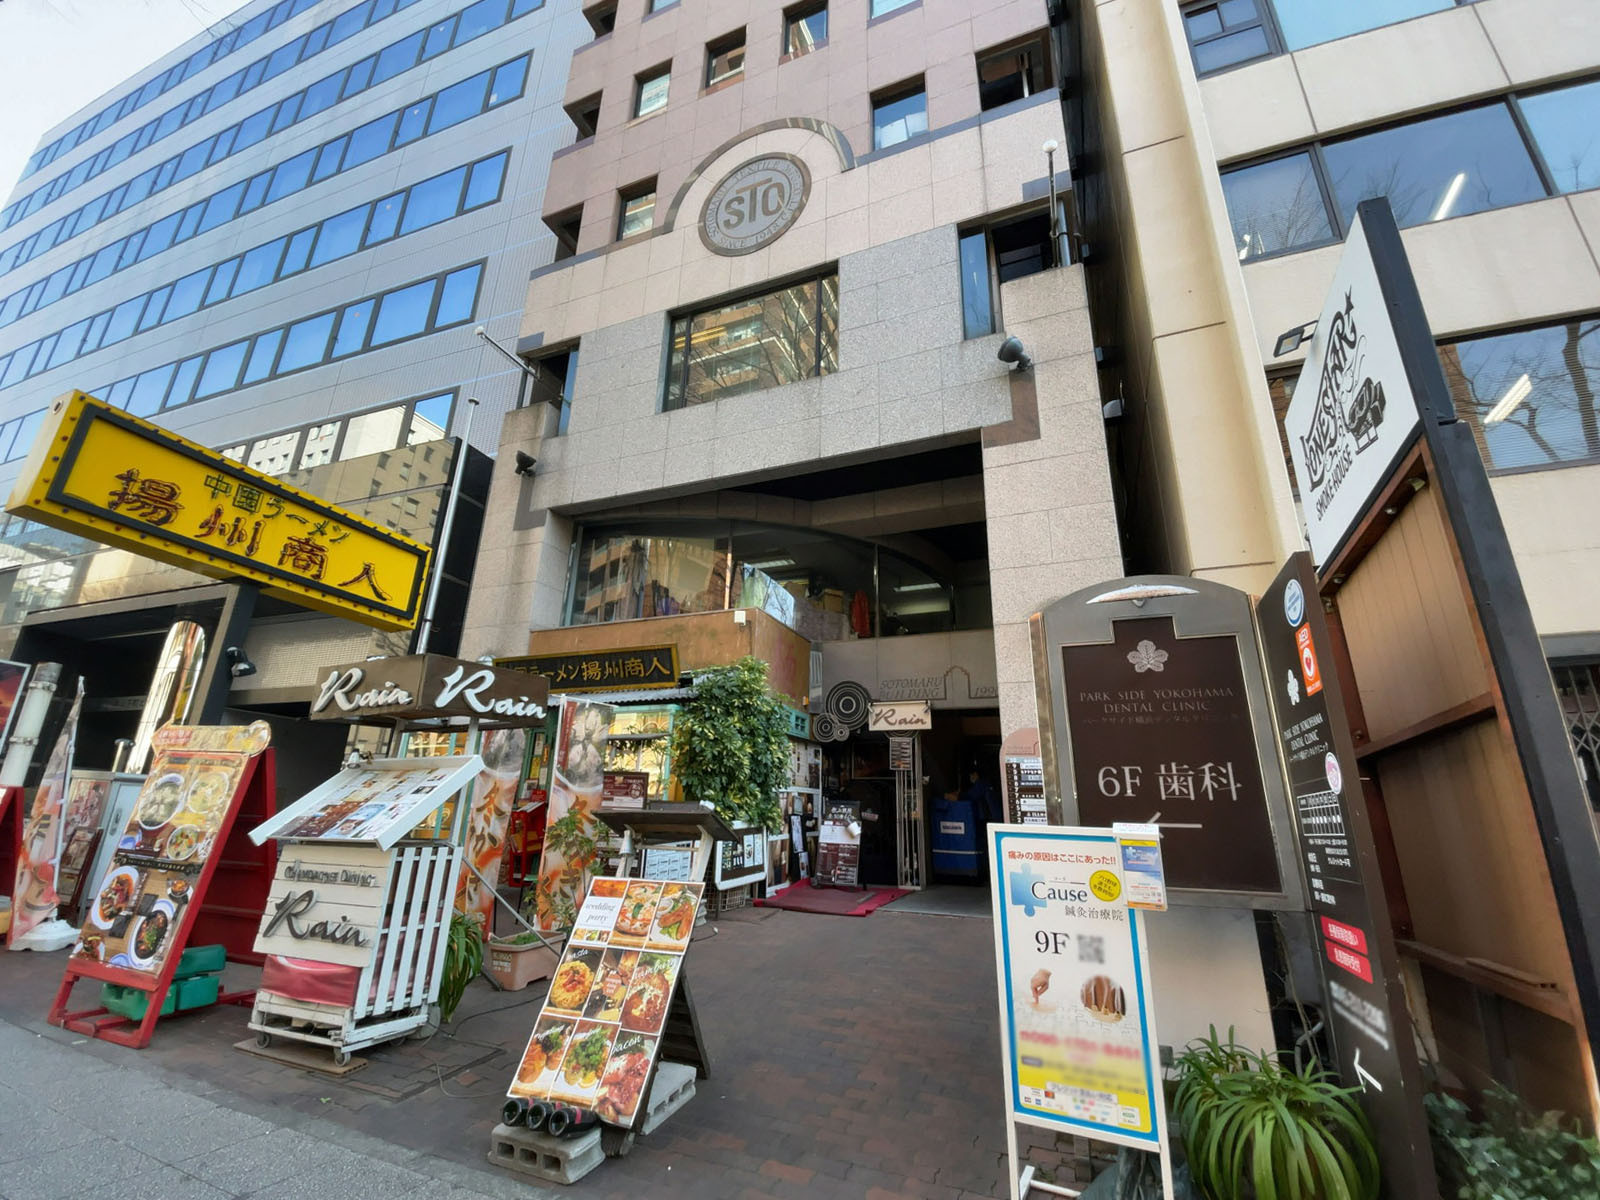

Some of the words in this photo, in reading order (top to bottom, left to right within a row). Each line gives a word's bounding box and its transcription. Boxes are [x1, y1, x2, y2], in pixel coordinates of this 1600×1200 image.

[723, 177, 786, 230] STO
[204, 473, 351, 543] 中国ラーメン
[107, 468, 393, 602] 揚州商人
[313, 667, 414, 712] Rain
[435, 665, 547, 719] Rain
[1080, 692, 1111, 702] PARK
[1119, 689, 1145, 700] SIDE
[1153, 687, 1234, 700] YOKOHAMA
[871, 708, 927, 726] Rain
[1103, 702, 1154, 714] DENTAL
[1162, 701, 1210, 713] CLINIC
[1098, 766, 1143, 798] 6F
[1154, 761, 1242, 801] 歯科
[585, 902, 616, 911] wedding
[1031, 881, 1088, 903] Cause
[263, 889, 368, 946] Rain
[1065, 905, 1124, 921] 鍼灸治療院
[1035, 930, 1070, 955] 9F
